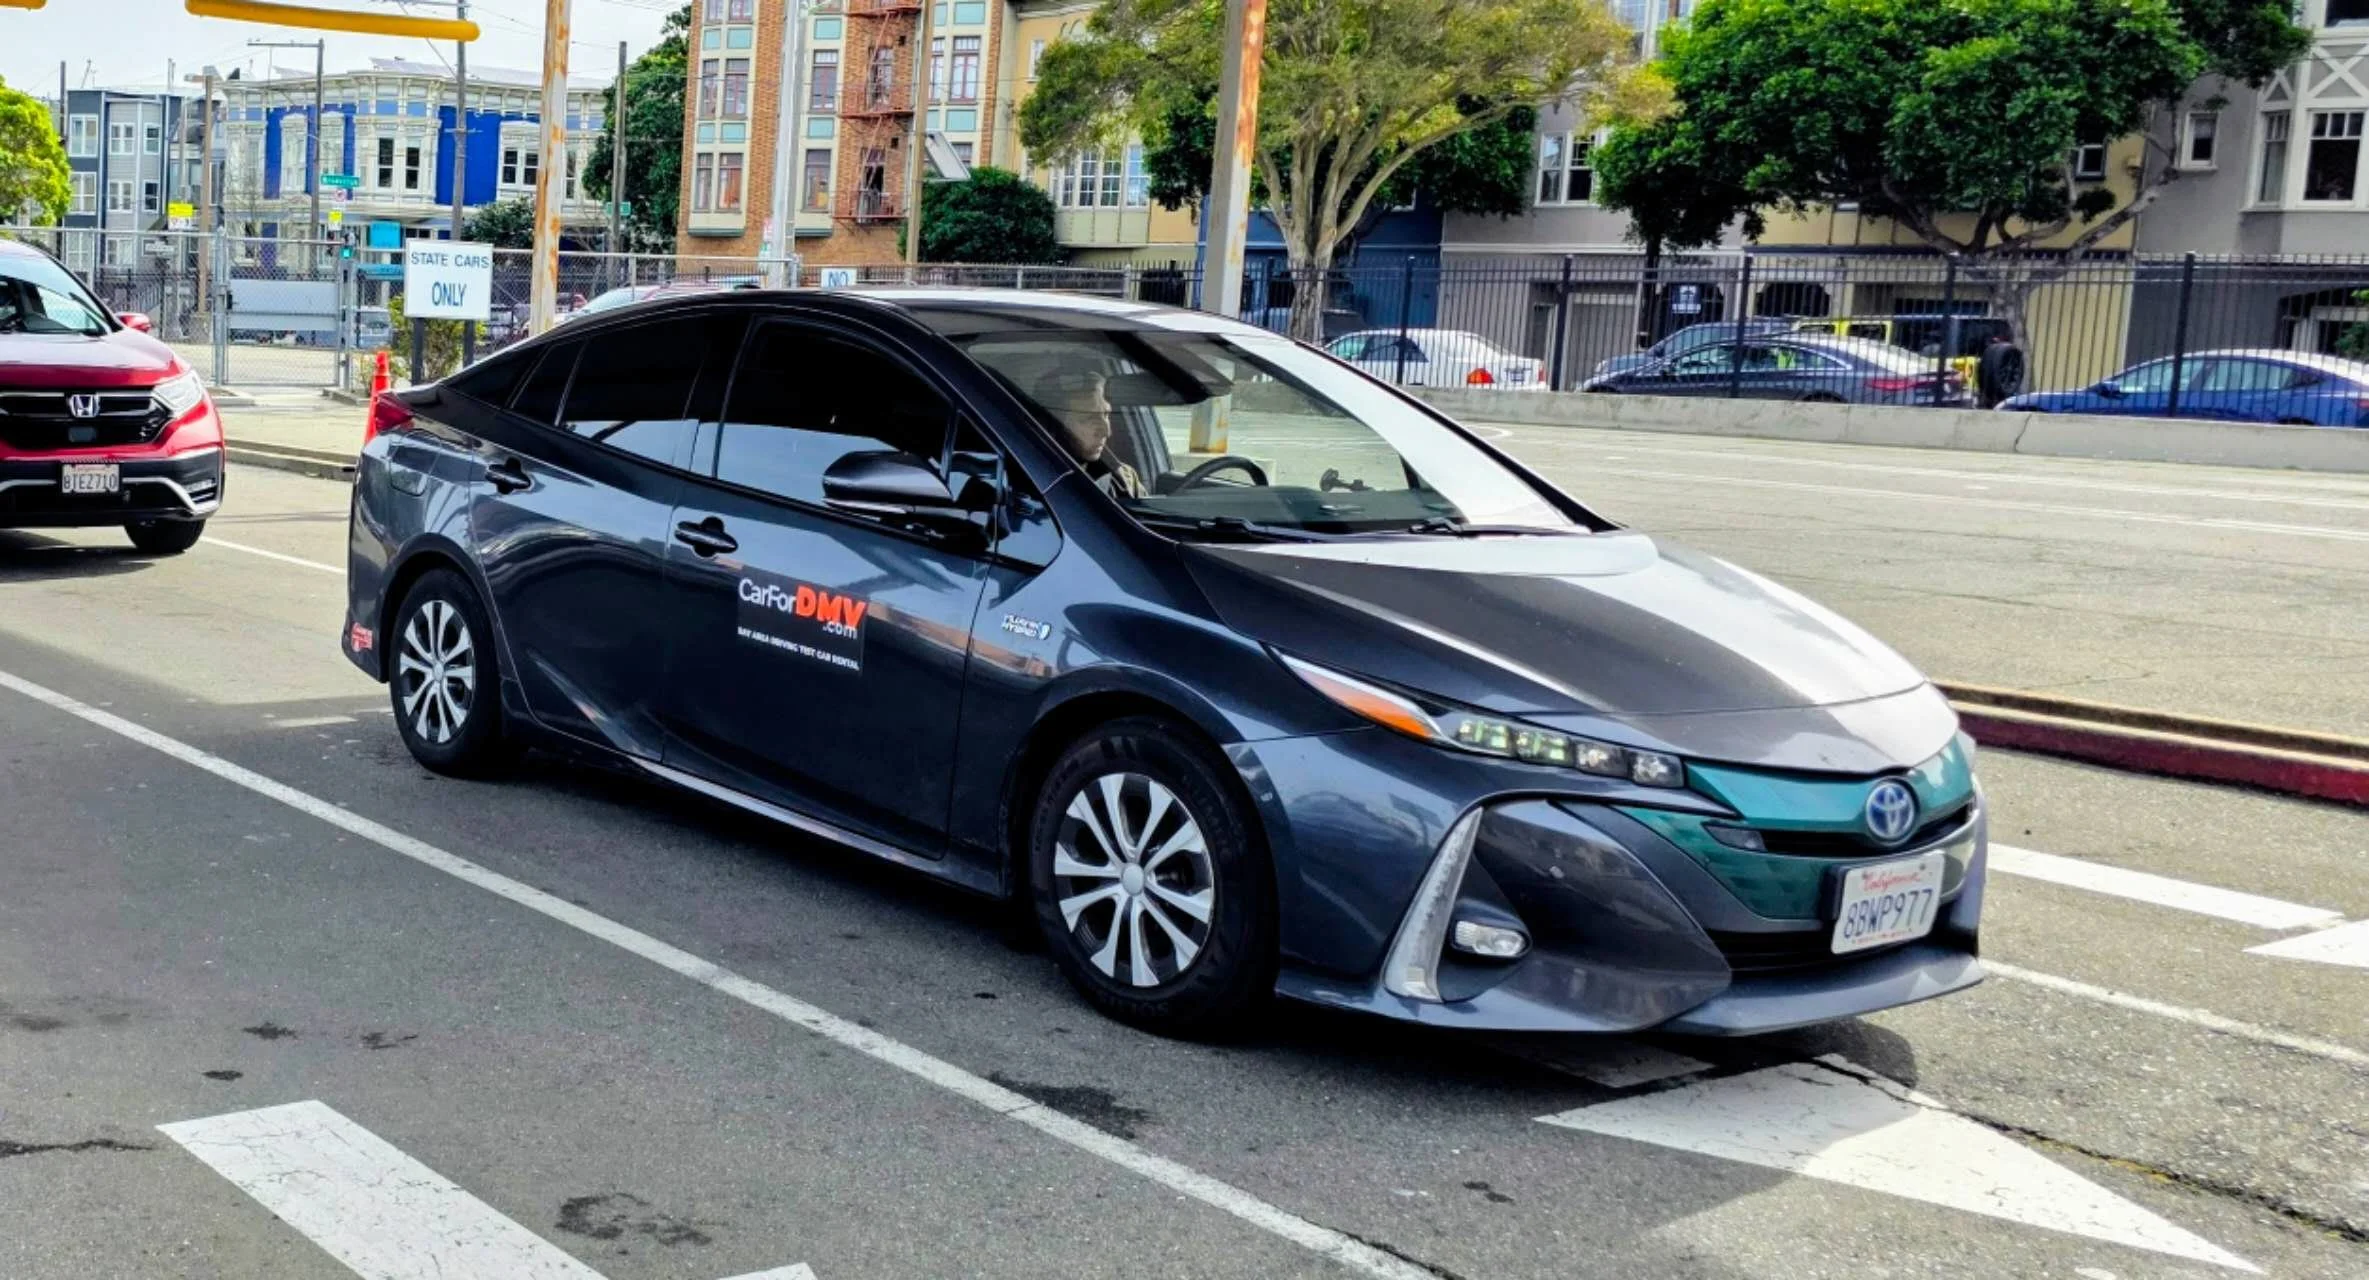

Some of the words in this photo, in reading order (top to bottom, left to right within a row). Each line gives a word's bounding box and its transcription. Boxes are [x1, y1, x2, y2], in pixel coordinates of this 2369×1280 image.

[411, 251, 449, 267] STATE
[454, 254, 490, 269] CARS
[432, 281, 467, 307] ONLY
[738, 578, 867, 629] CarForDMV
[822, 619, 858, 640] .com
[816, 650, 832, 662] CAR
[831, 654, 860, 671] RENTAL
[1843, 888, 1933, 939] 8BWP977
